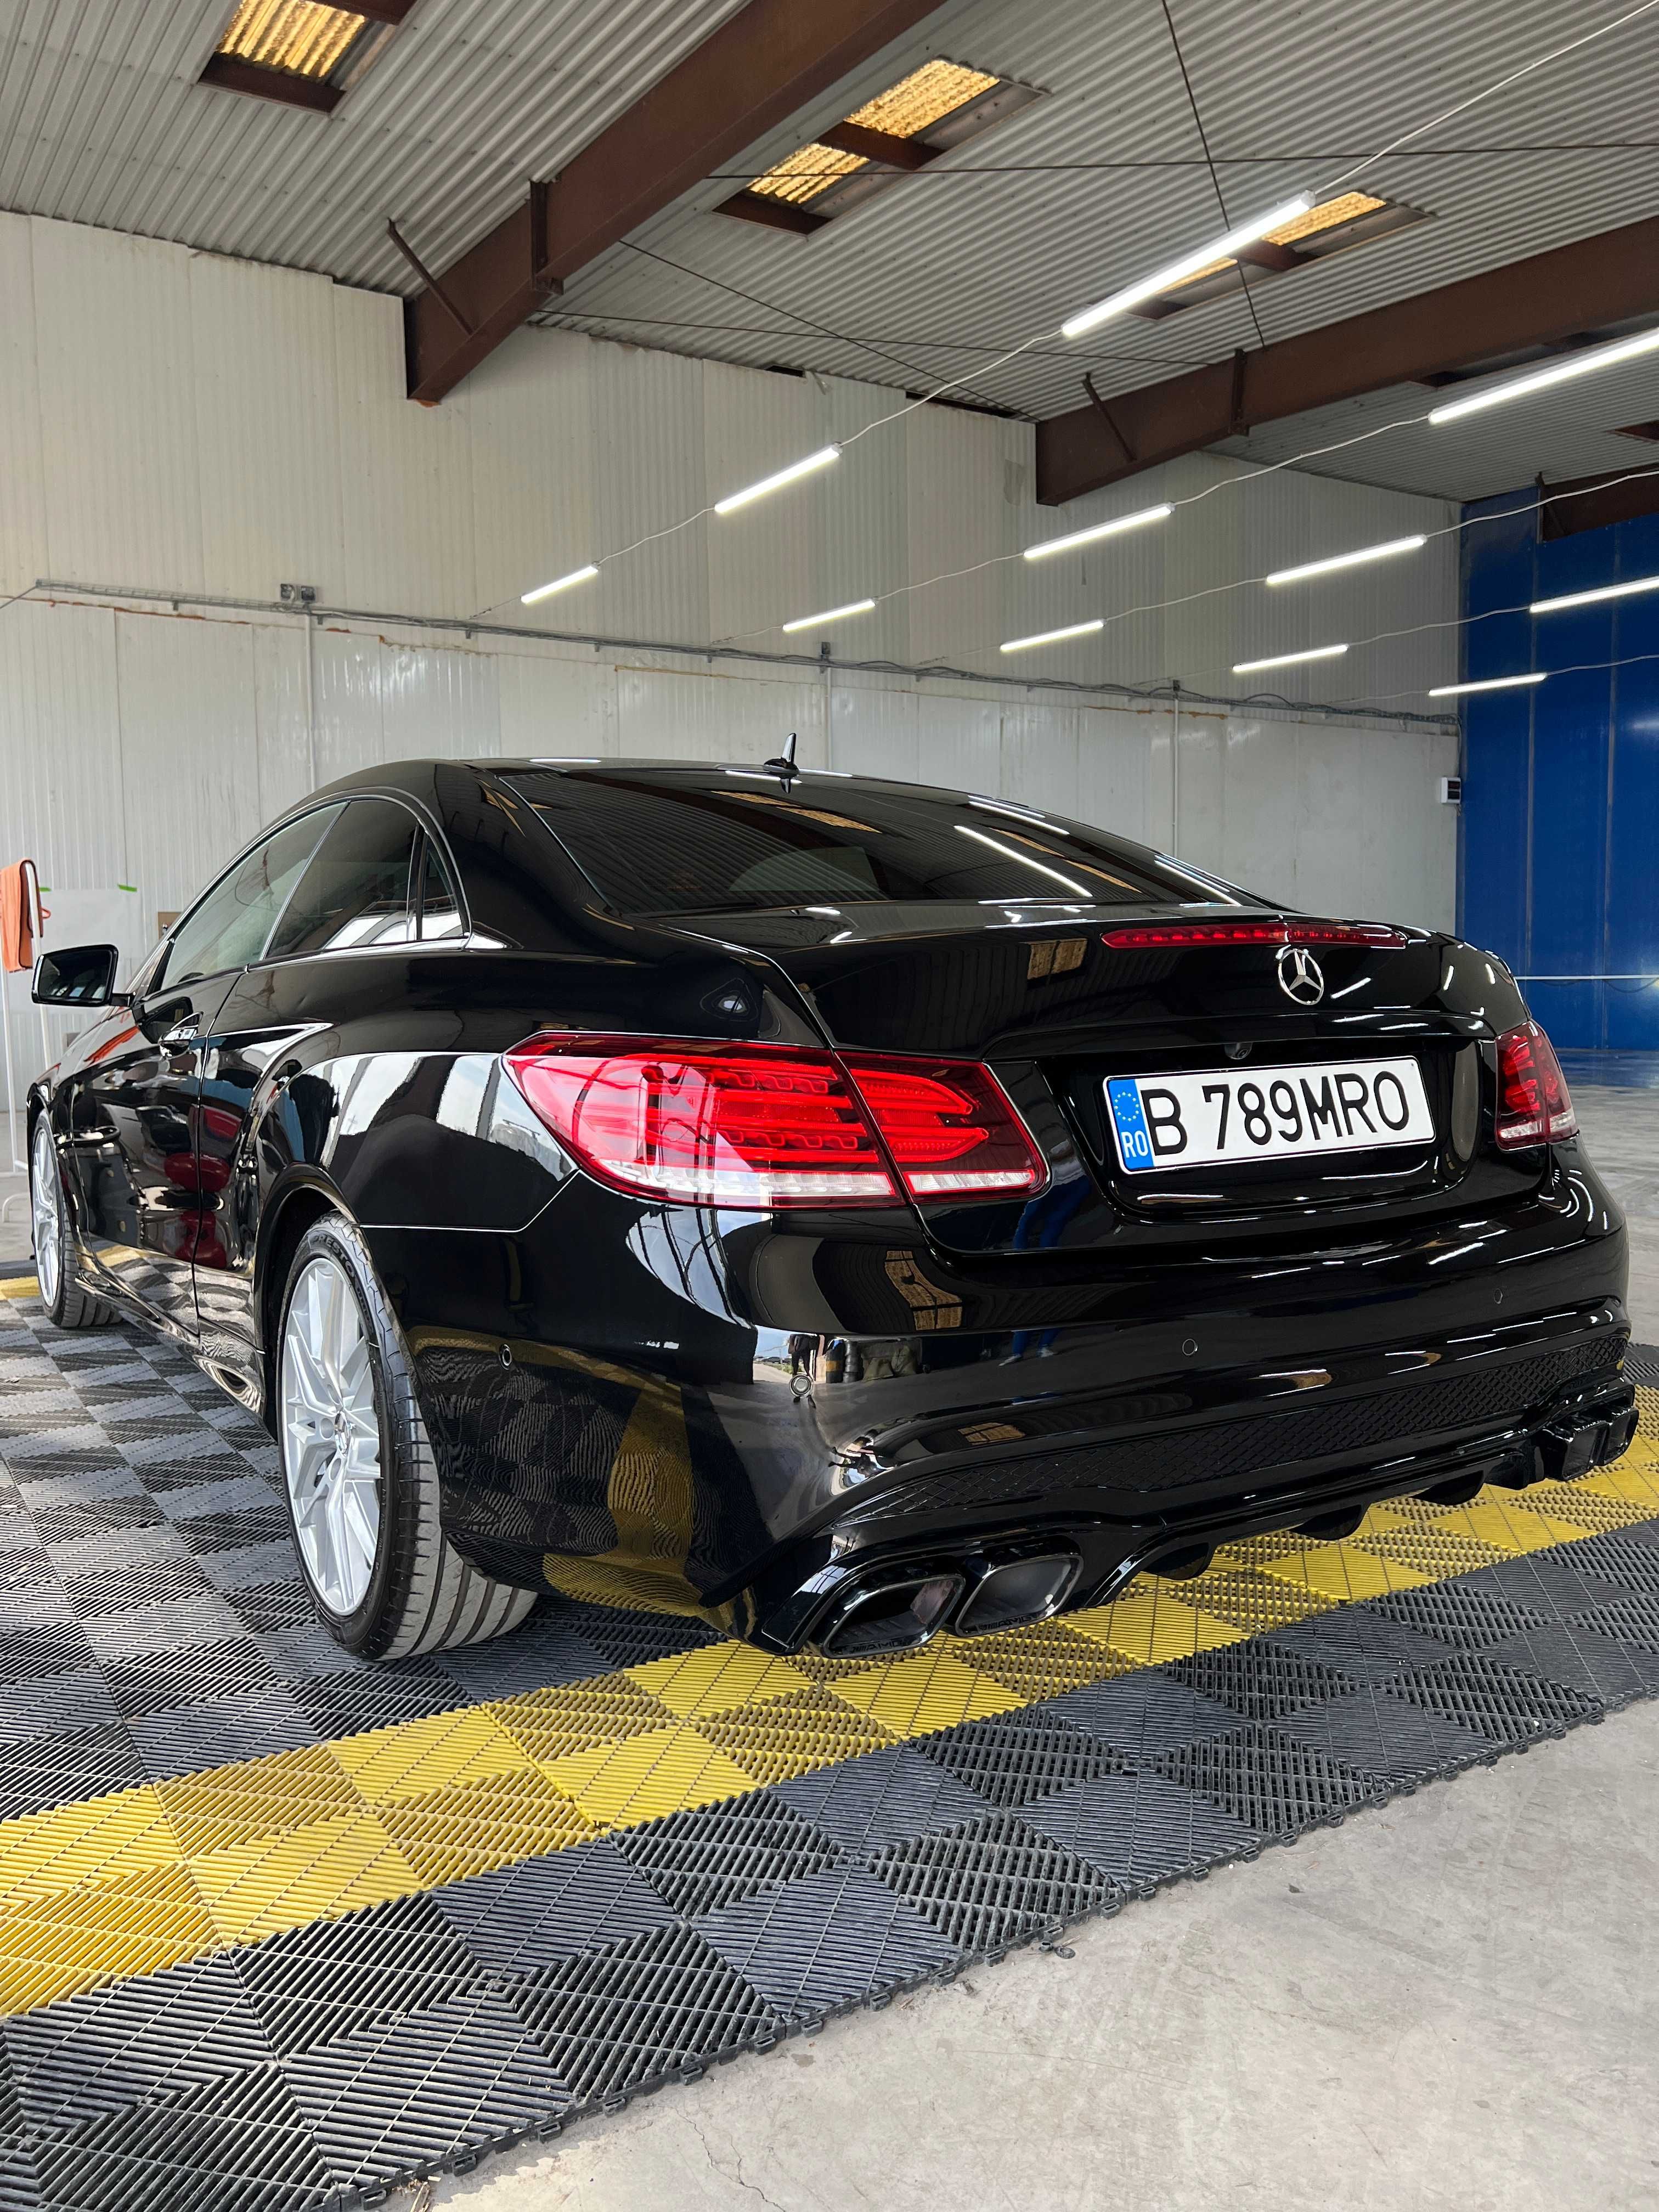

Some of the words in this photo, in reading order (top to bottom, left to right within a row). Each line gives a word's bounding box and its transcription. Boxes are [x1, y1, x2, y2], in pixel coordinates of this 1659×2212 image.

[1140, 1088, 1187, 1156] B
[1202, 1071, 1409, 1150] 789MRO
[1121, 1130, 1149, 1159] RO
